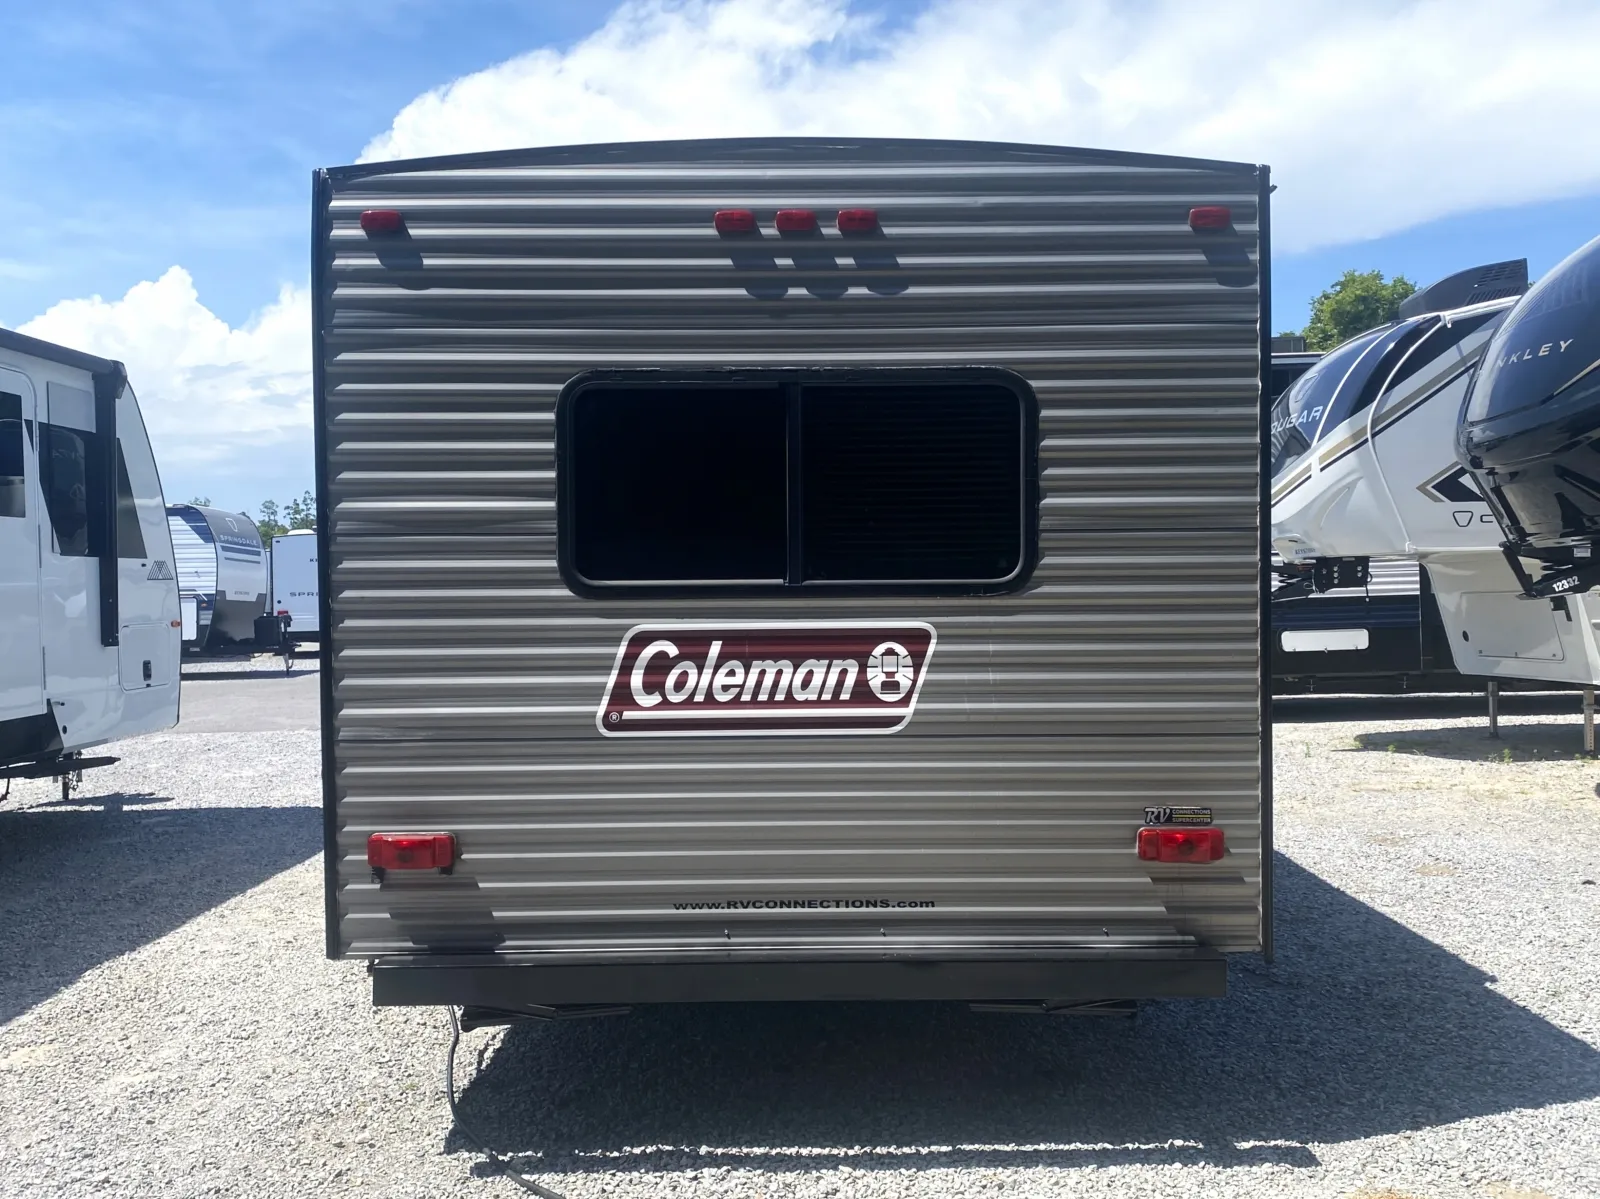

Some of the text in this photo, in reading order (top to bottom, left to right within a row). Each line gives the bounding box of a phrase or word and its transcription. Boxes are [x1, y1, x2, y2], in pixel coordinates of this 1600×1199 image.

[219, 534, 258, 546] SPRINGDALE
[1552, 575, 1581, 592] 12332
[629, 639, 860, 708] Coleman
[1144, 807, 1171, 823] RV
[672, 899, 936, 911] www.RVCONNECTIONS.com
